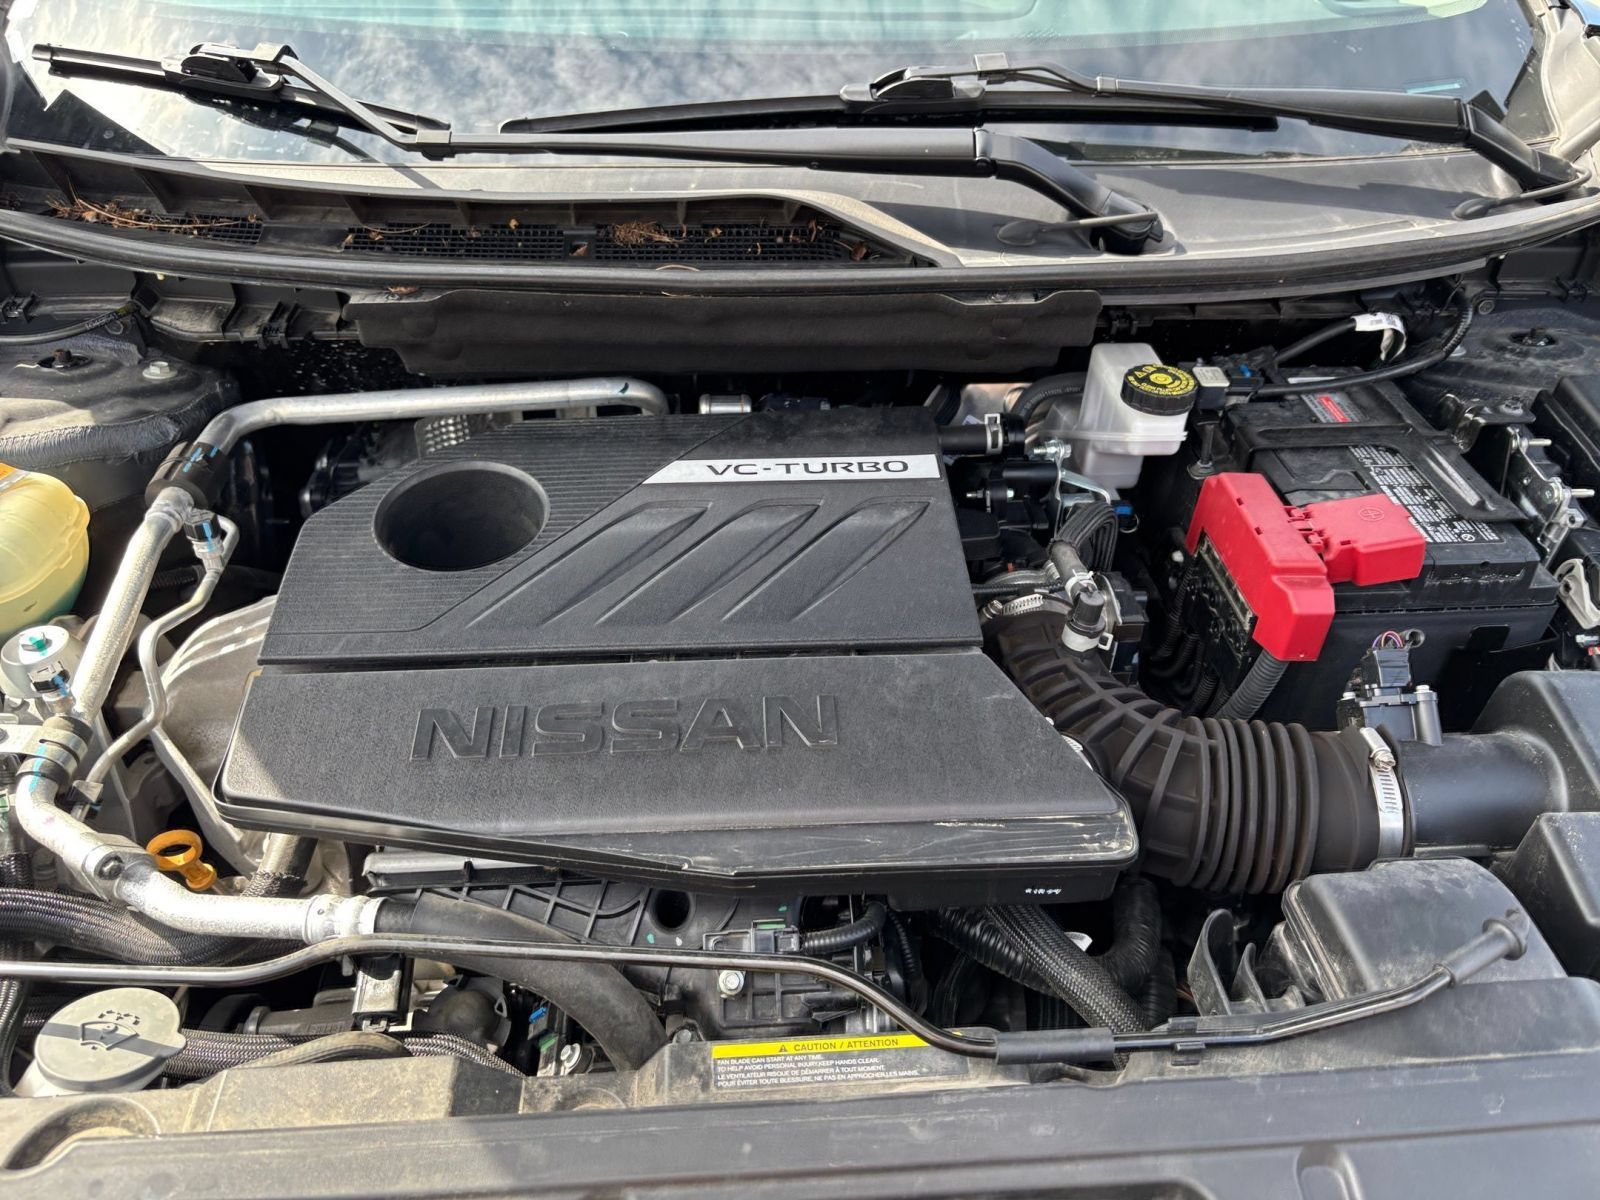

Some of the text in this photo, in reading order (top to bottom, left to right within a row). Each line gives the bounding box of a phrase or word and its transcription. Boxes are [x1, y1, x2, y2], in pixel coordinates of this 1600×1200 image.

[706, 460, 909, 476] VC-TURBO
[409, 694, 838, 760] NISSAN
[794, 1042, 836, 1052] CAUTION
[847, 1039, 898, 1049] ATTENTION
[731, 1057, 750, 1065] BLADE
[726, 1072, 766, 1080] VENTILATEUR
[759, 1077, 779, 1085] TOUTE
